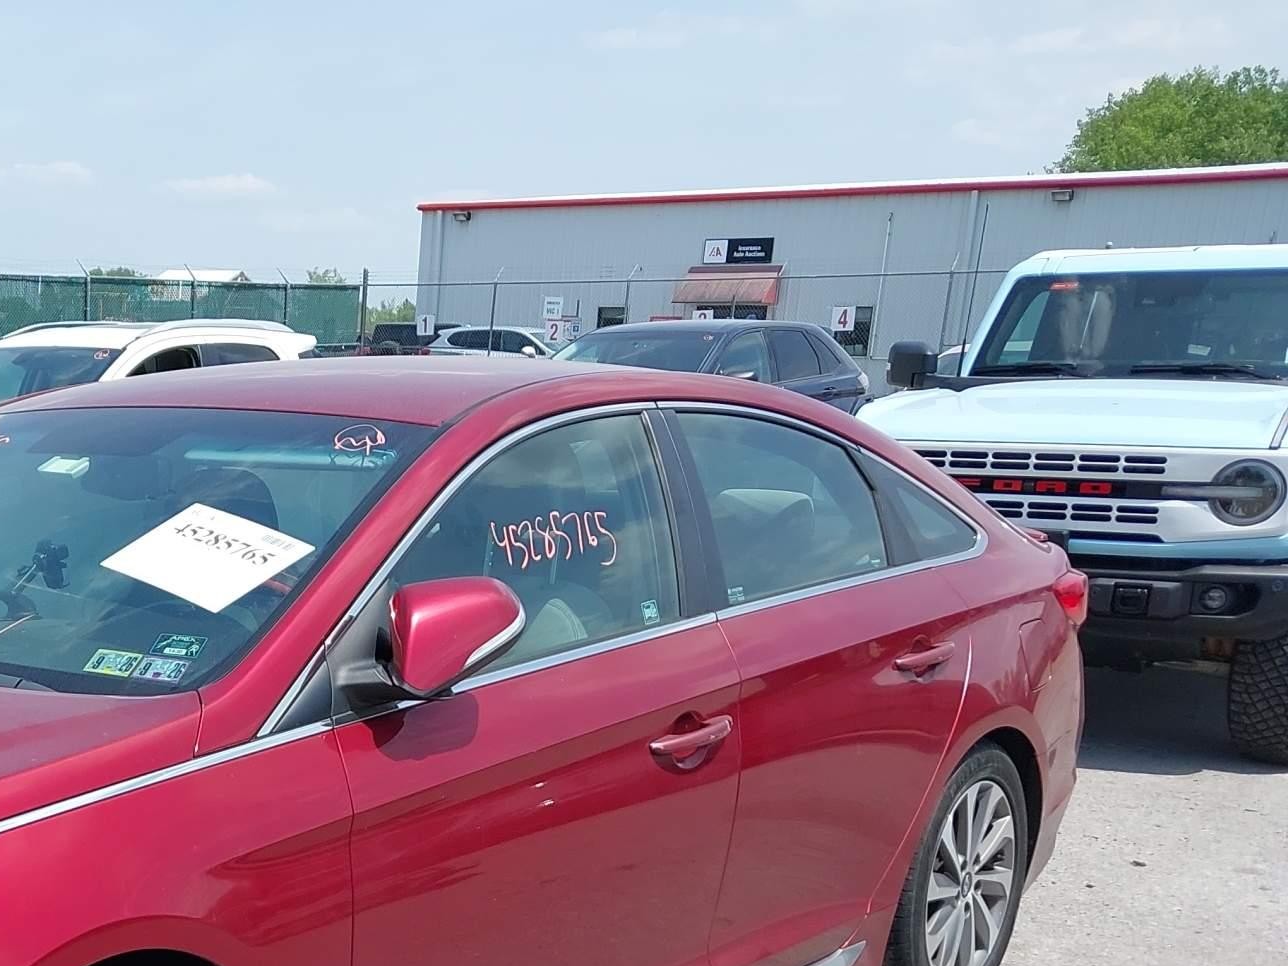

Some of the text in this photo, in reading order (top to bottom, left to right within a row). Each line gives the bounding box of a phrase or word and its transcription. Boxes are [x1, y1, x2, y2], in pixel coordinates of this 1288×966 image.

[422, 316, 428, 333] 1
[838, 309, 848, 328] 4
[550, 323, 558, 341] 2
[174, 523, 276, 565] 45285765
[491, 511, 617, 569] 45285765
[93, 656, 138, 672] 9 26
[139, 662, 187, 679] 9 26
